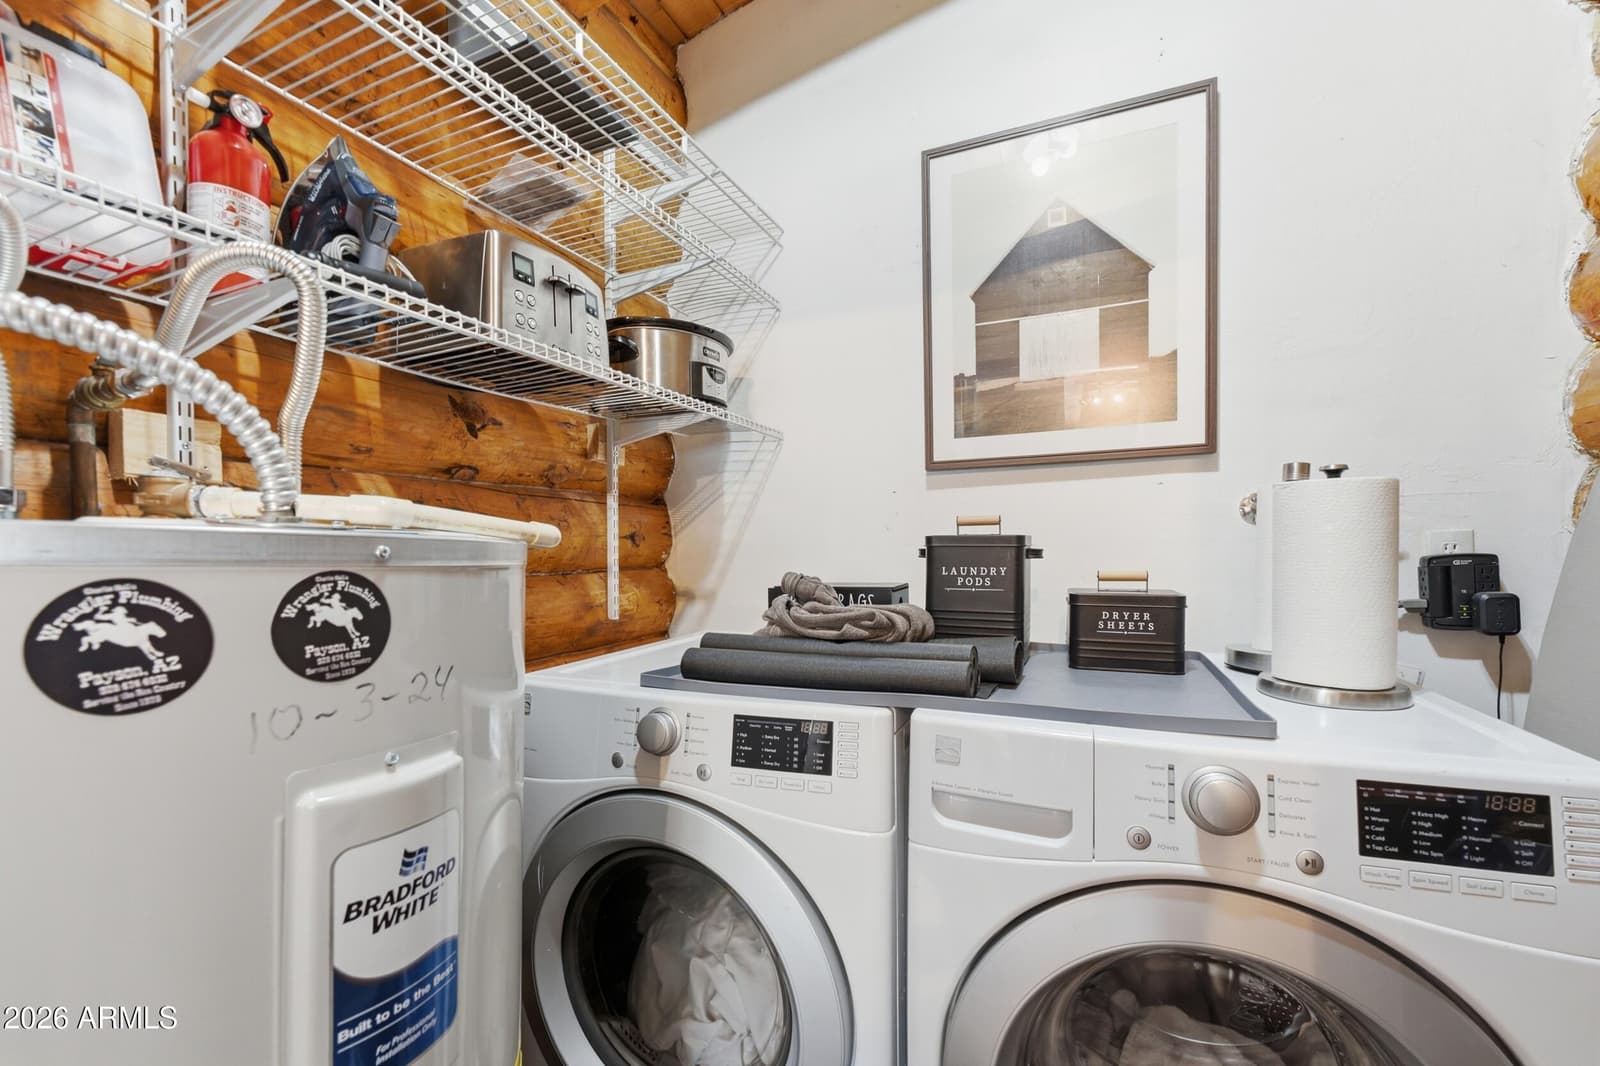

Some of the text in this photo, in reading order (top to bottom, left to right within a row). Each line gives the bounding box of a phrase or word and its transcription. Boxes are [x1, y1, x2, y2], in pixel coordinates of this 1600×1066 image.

[941, 566, 1007, 576] LAUNDRY
[956, 577, 991, 586] PODS
[280, 580, 380, 618] Wrangler Plumbing
[35, 590, 194, 642] Wrangler Plumbing
[1102, 611, 1151, 621] DRYER
[1098, 621, 1155, 631] SHEETS
[352, 635, 371, 650] AZ
[152, 655, 182, 674] AZ
[1418, 820, 1433, 828] High
[1434, 812, 1449, 820] High
[342, 857, 456, 925] BRADFORD
[372, 886, 440, 935] WHITE
[337, 963, 454, 1044] Built to be the Best
[375, 1039, 391, 1056] For
